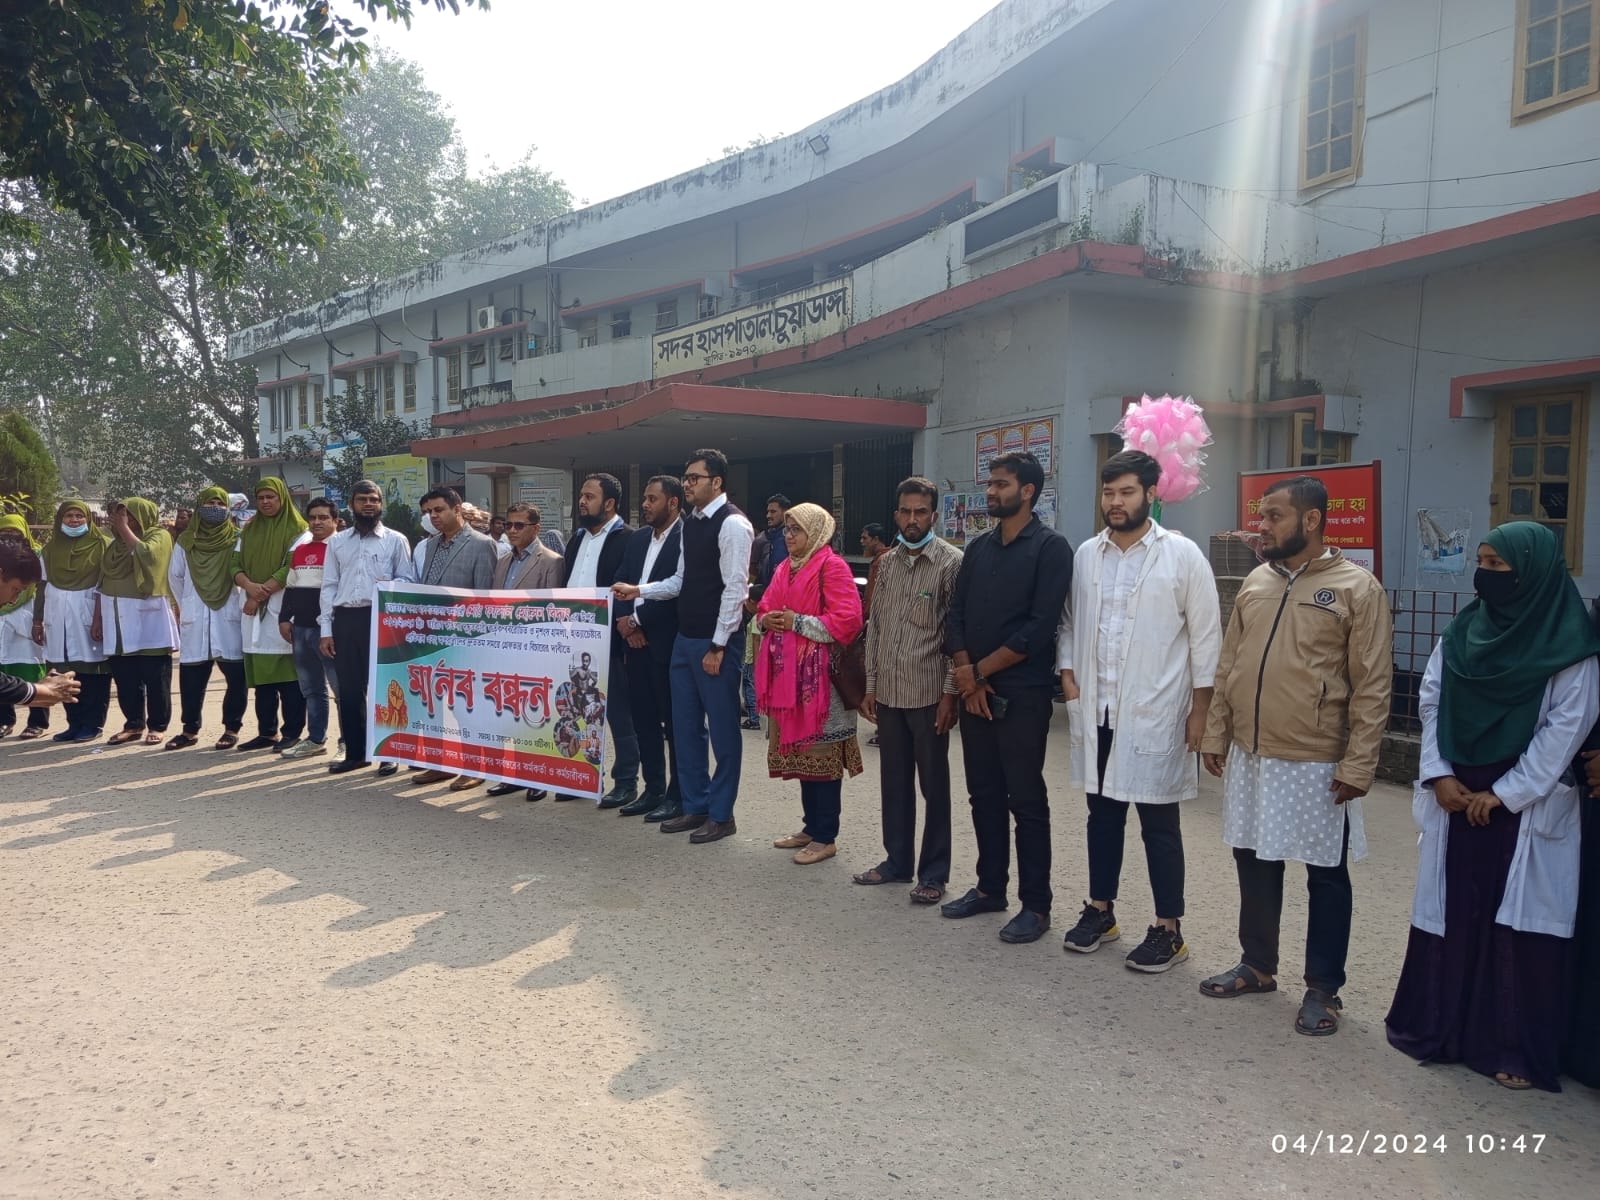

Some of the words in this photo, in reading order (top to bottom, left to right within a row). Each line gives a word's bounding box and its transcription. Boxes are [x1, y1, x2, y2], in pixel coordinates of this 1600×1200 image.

[658, 333, 694, 362] সদর
[1350, 497, 1366, 511] হয়
[481, 672, 554, 724] বন্ধন
